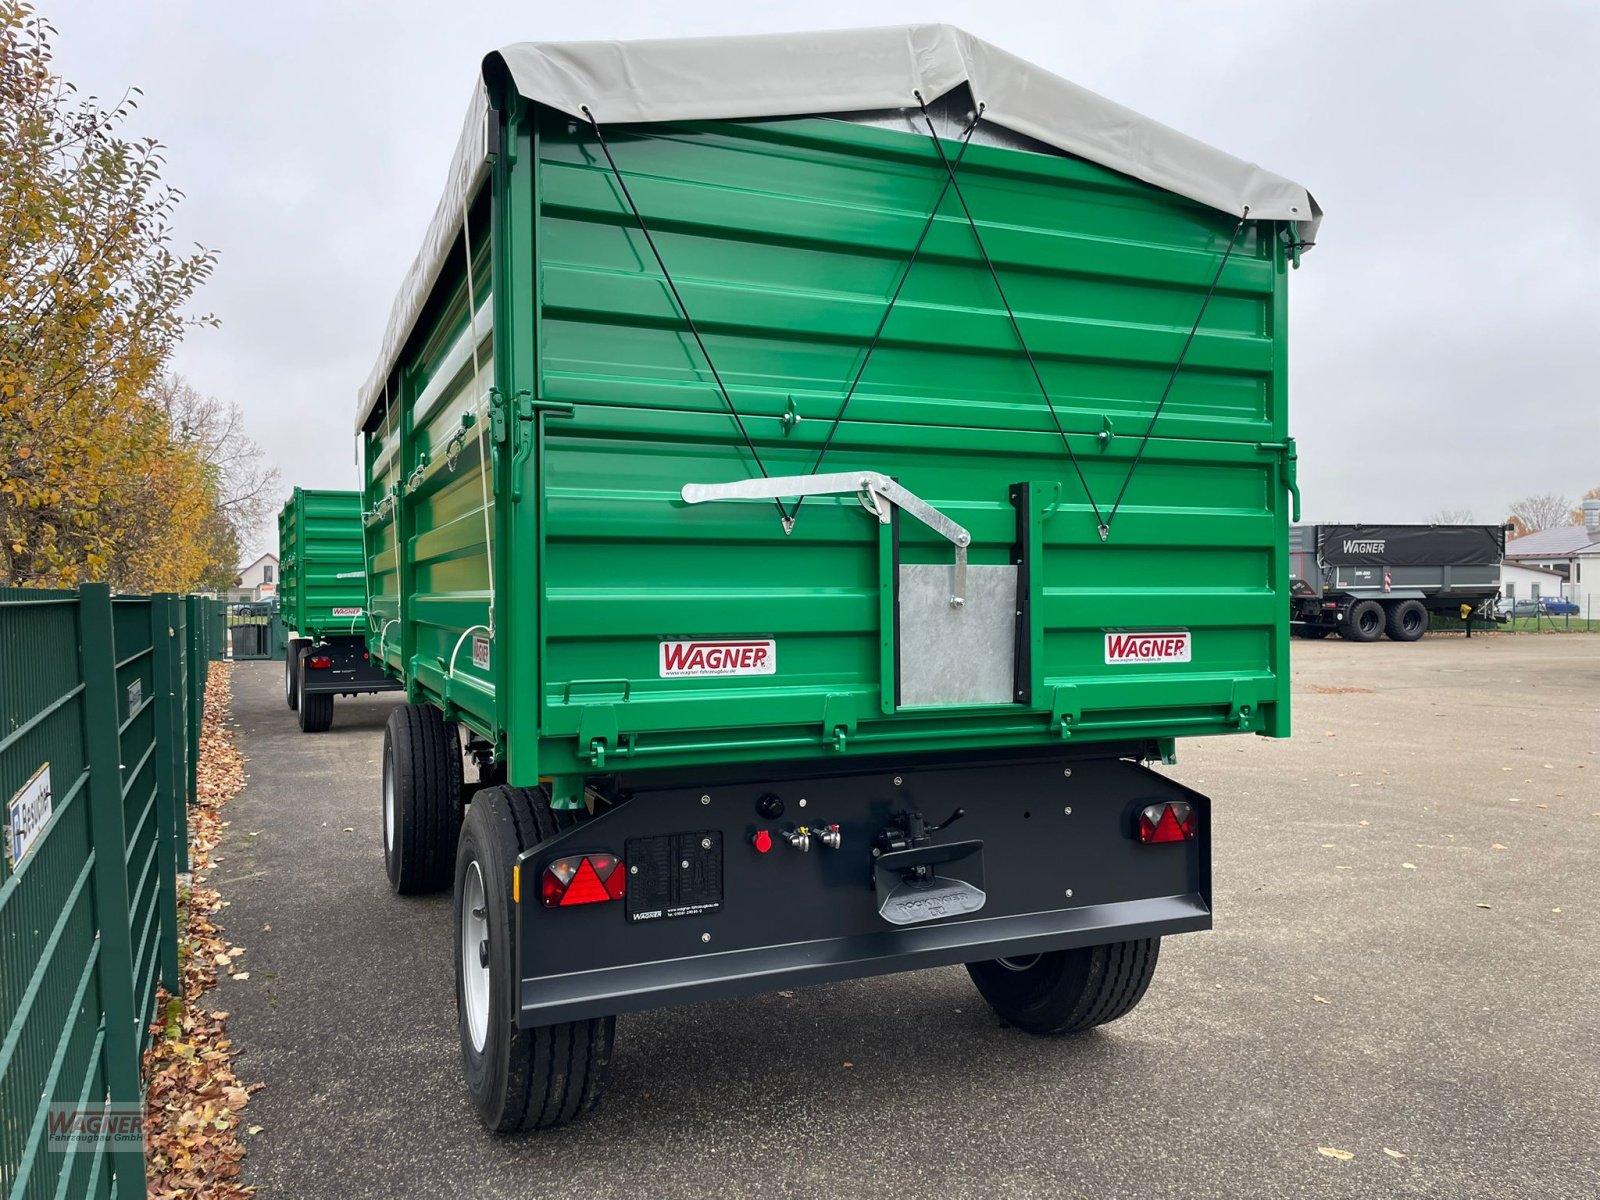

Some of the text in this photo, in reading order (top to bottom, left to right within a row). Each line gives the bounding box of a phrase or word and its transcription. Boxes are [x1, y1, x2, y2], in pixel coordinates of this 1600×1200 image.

[1343, 540, 1386, 554] WAGNER
[1108, 634, 1187, 658] WAGNER
[664, 642, 770, 670] WAGNER
[633, 911, 662, 921] WAGNER
